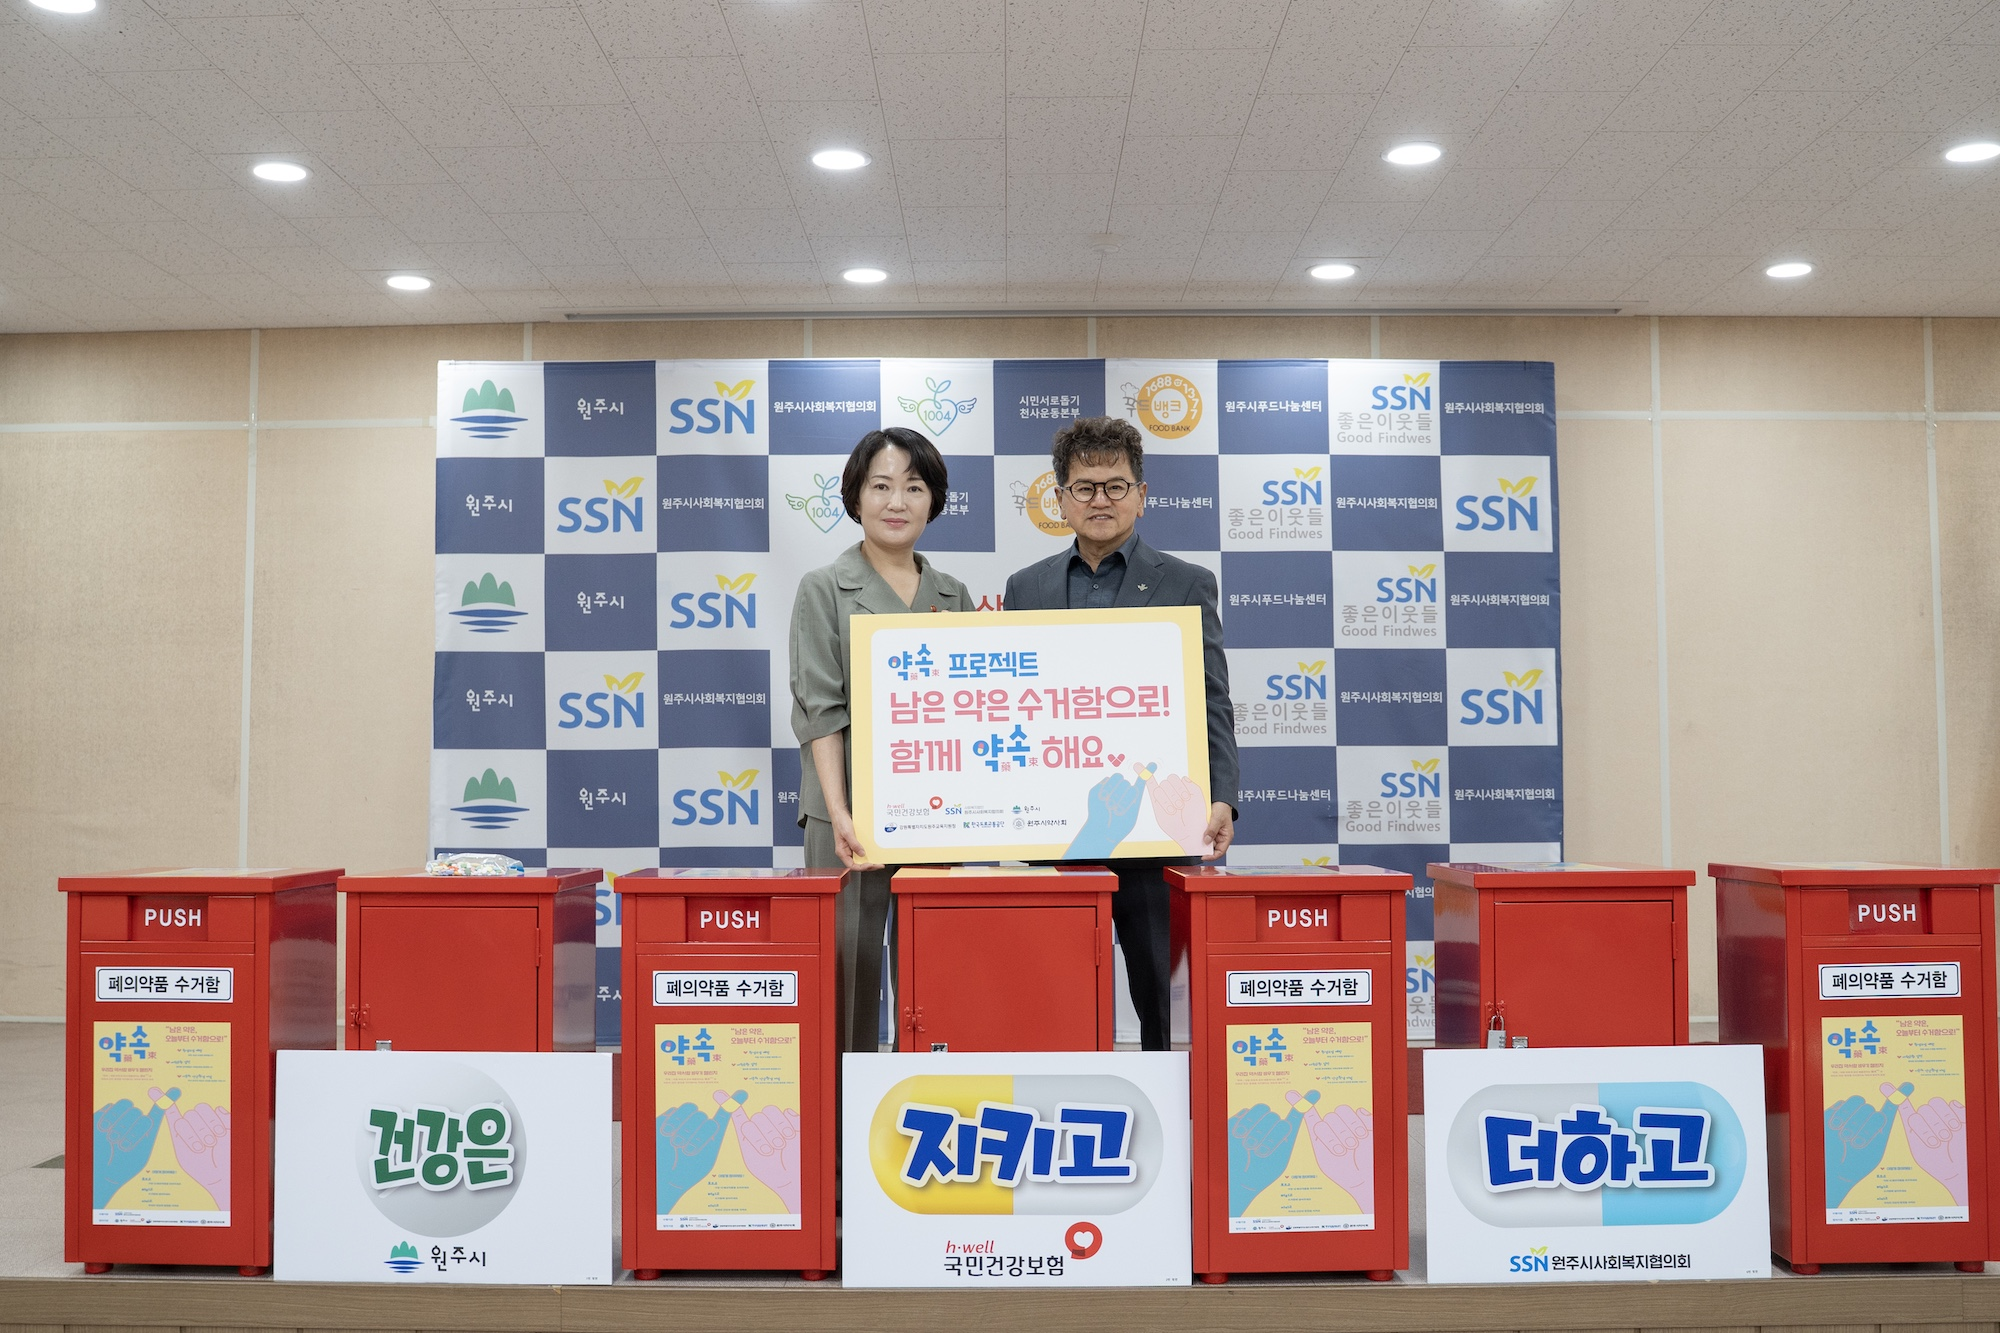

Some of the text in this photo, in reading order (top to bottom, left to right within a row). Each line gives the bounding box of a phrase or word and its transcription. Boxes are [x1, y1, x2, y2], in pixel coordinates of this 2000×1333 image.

[773, 401, 877, 413] 원주시사회복지협의회
[1019, 395, 1080, 407] 시민서로돕기
[1225, 400, 1322, 413] 원주시푸드나눔센터
[1371, 386, 1431, 411] SSN
[1444, 402, 1545, 415] 원주시사회복지협의회
[577, 398, 624, 420] 원주시
[669, 398, 755, 434] SSN
[924, 410, 951, 421] 1004
[1019, 407, 1081, 419] 천사운동본부
[1149, 424, 1190, 432] FOOD BANK
[1337, 412, 1432, 431] 좋은이웃들
[1337, 432, 1431, 444] Good Findwes
[1144, 497, 1213, 509] 푸드나눔센터
[1262, 480, 1322, 506] SSN
[465, 494, 513, 516] 원주시
[662, 497, 765, 510] 원주시사회복지협의회
[812, 507, 840, 518] 1004
[1336, 497, 1438, 510] 원주시사회복지협의회
[1455, 495, 1539, 531] SSN
[557, 497, 643, 533] SSN
[1228, 508, 1324, 526] 좋은이웃들
[1228, 527, 1323, 540] Good Findwes
[1229, 594, 1327, 606] 원주시푸드나눔센터
[1376, 577, 1437, 603] SSN
[577, 592, 625, 614] 원주시
[669, 592, 756, 629] SSN
[1450, 594, 1550, 607] 원주시사회복지협의회
[1341, 605, 1438, 624] 좋은이웃들
[1341, 624, 1437, 637] Good Findwes
[888, 643, 1039, 681] 약속 프로젝트
[1266, 674, 1326, 701] SSN
[1340, 691, 1443, 704] 원주시사회복지협의회
[466, 689, 514, 712] 원주시
[663, 693, 766, 705] 원주시사회복지협의회
[890, 685, 1170, 724] 남은 약은 수거함으로!
[1460, 688, 1543, 726] SSN
[558, 692, 645, 729] SSN
[1233, 702, 1328, 722] 좋은이웃들
[1233, 722, 1328, 735] Good Findwes
[890, 724, 1104, 774] 함께 약속 해요
[1380, 772, 1440, 798] SSN
[1454, 788, 1555, 801] 원주시사회복지협의회
[579, 787, 627, 811] 원주시
[671, 789, 759, 826] SSN
[1346, 800, 1442, 819] 좋은이웃들
[1345, 820, 1441, 833] Good Findwes
[145, 908, 201, 927] PUSH
[700, 910, 760, 929] PUSH
[1268, 909, 1328, 928] PUSH
[1858, 903, 1917, 923] PUSH
[108, 975, 221, 994] 폐의약품 수거함
[666, 979, 784, 998] 폐의약품 수거함
[1240, 977, 1358, 997] 폐의약품 수거함
[1832, 970, 1948, 991] 폐의약품 수거함
[98, 1025, 150, 1062] 약속
[660, 1028, 715, 1066] 약속
[1232, 1028, 1287, 1066] 약속
[1827, 1020, 1881, 1059] 약속
[369, 1108, 509, 1186] 건강은
[902, 1107, 1130, 1182] 지키고
[1485, 1110, 1709, 1186] 더하고
[430, 1245, 487, 1272] 원주시
[943, 1255, 1064, 1277] 국민건강보험
[1509, 1254, 1691, 1273] SSN 원주시사회복지협의회
